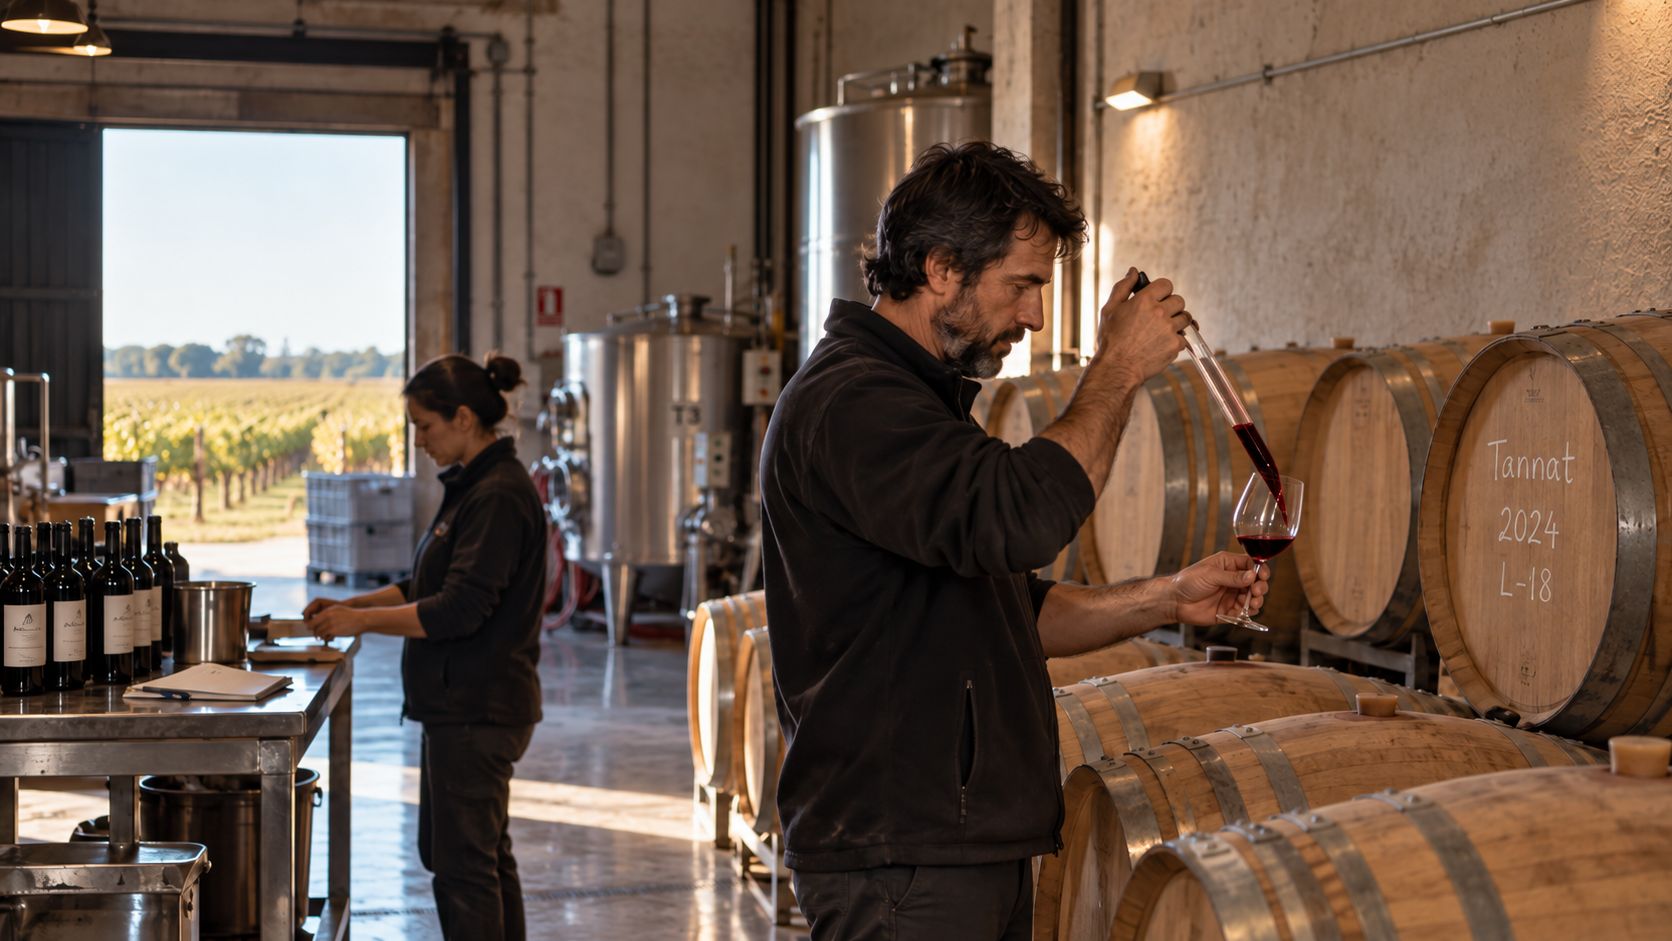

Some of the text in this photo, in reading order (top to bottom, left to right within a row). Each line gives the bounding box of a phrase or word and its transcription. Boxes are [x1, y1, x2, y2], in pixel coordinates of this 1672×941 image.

[671, 404, 702, 426] T3
[1487, 439, 1576, 484] Tannat
[1498, 506, 1560, 550] 2024
[1500, 560, 1552, 603] L-18
